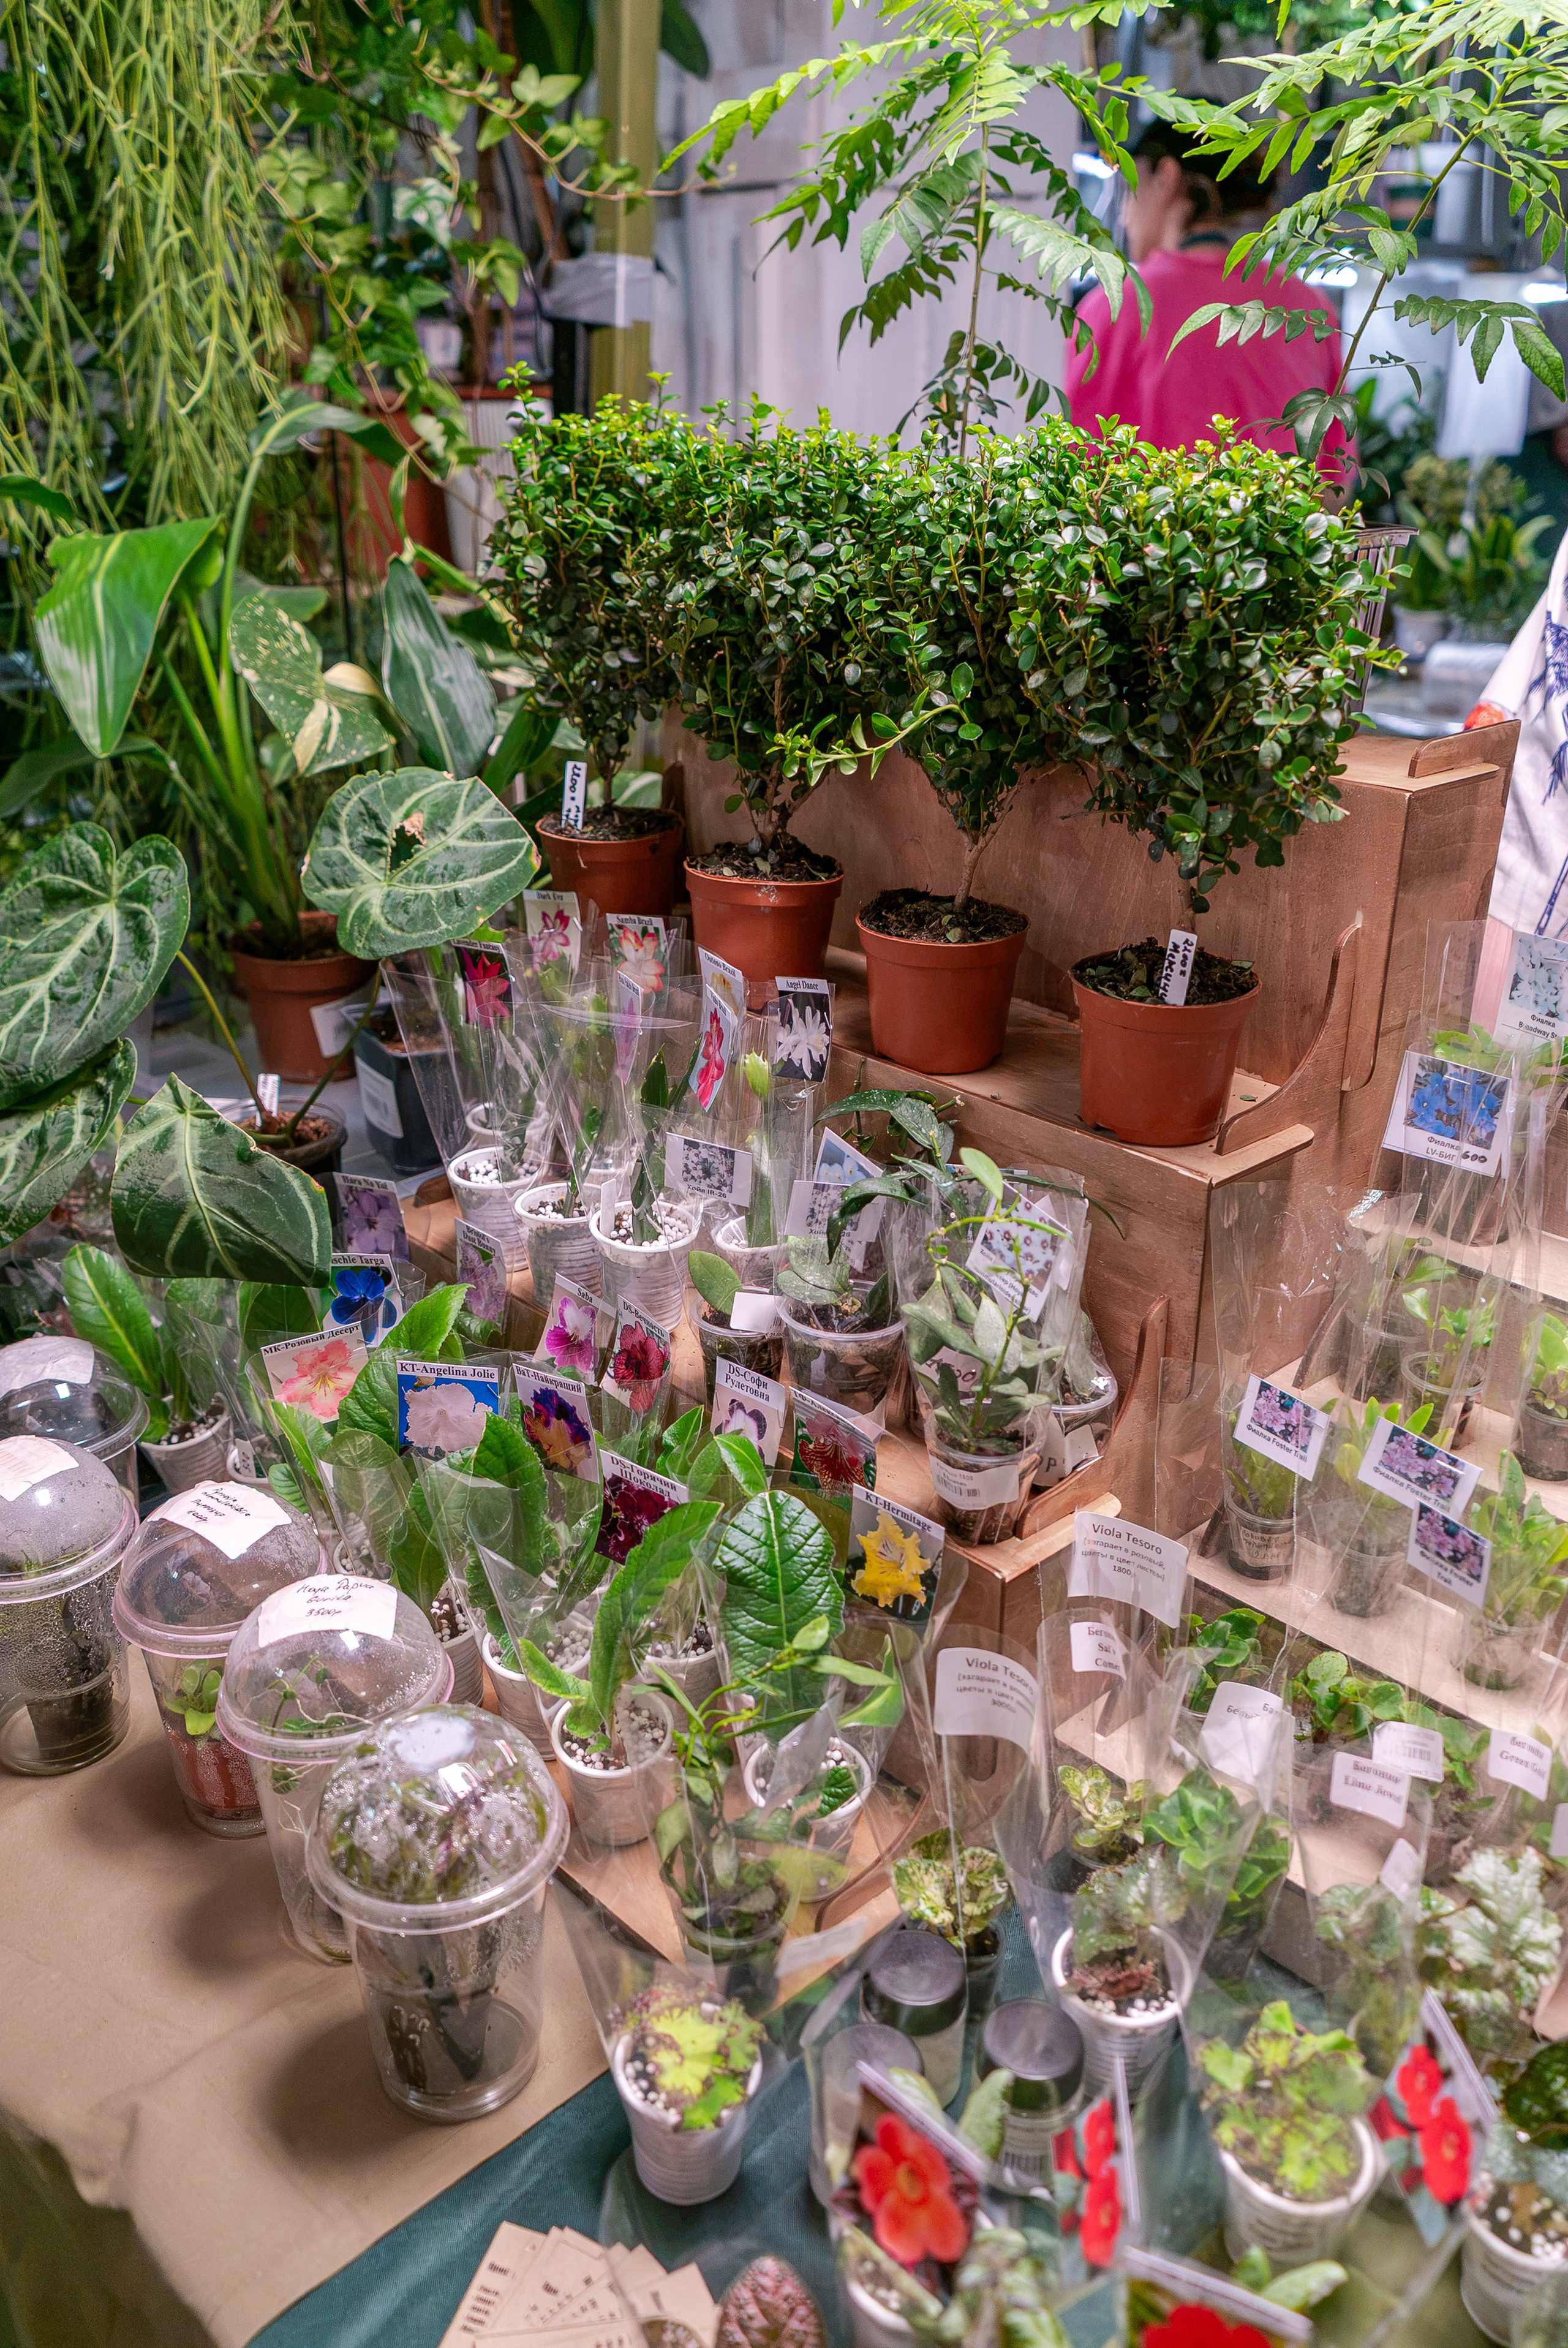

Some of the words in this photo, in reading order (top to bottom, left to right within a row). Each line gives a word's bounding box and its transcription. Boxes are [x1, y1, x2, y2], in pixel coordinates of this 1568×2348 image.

[785, 980, 801, 991] Angel
[802, 981, 819, 991] Dance
[1531, 1014, 1556, 1029] Фиалка
[1426, 1147, 1457, 1161] LV-БИГ
[1427, 1136, 1461, 1151] Фиалка
[1461, 1151, 1488, 1163] 600
[360, 1256, 385, 1266] Targa
[577, 1287, 594, 1304] Saba
[623, 1300, 665, 1337] DS-Вечность
[263, 1333, 325, 1356] МК-Розовый
[328, 1324, 360, 1338] Десерт
[400, 1362, 467, 1377] KT-Angelina
[470, 1367, 495, 1379] Jolie
[728, 1363, 768, 1391] DS-Софи
[725, 1373, 770, 1403] Рулетовна
[1246, 1424, 1271, 1442] Фиалка
[1272, 1438, 1293, 1455] Foster
[620, 1468, 671, 1498] Шоколад
[1373, 1466, 1404, 1487] Фиалка
[1405, 1484, 1432, 1501] Foster
[865, 1491, 932, 1531] KT-Hermitage
[1093, 1523, 1121, 1539] Viola
[1126, 1532, 1162, 1555] Tesoro
[965, 1657, 998, 1672] Viola
